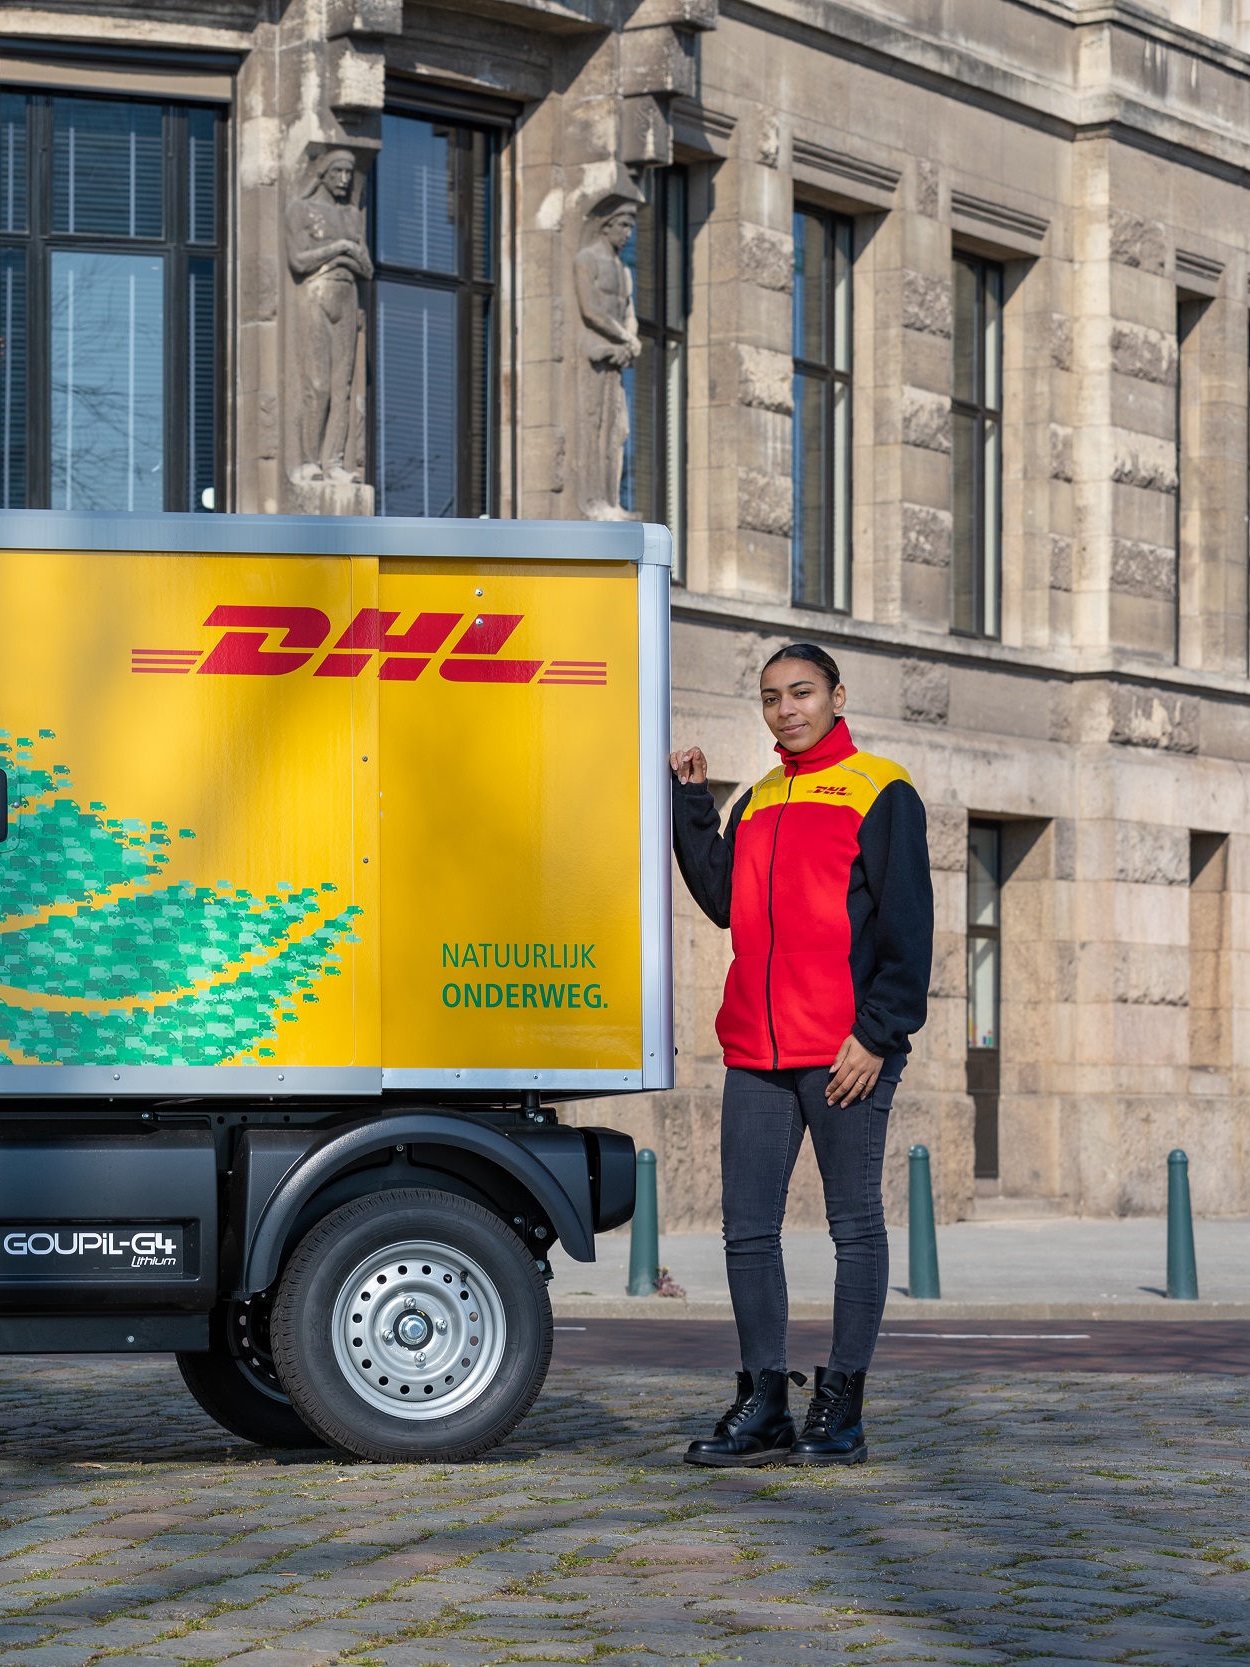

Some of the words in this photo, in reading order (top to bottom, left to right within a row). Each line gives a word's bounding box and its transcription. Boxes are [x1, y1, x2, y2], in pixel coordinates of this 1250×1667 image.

[195, 604, 545, 684] DHL
[813, 785, 847, 796] DHL
[442, 943, 597, 969] NATUURLIJK
[442, 983, 609, 1009] ONDERWEG.
[131, 1255, 177, 1268] Lithium
